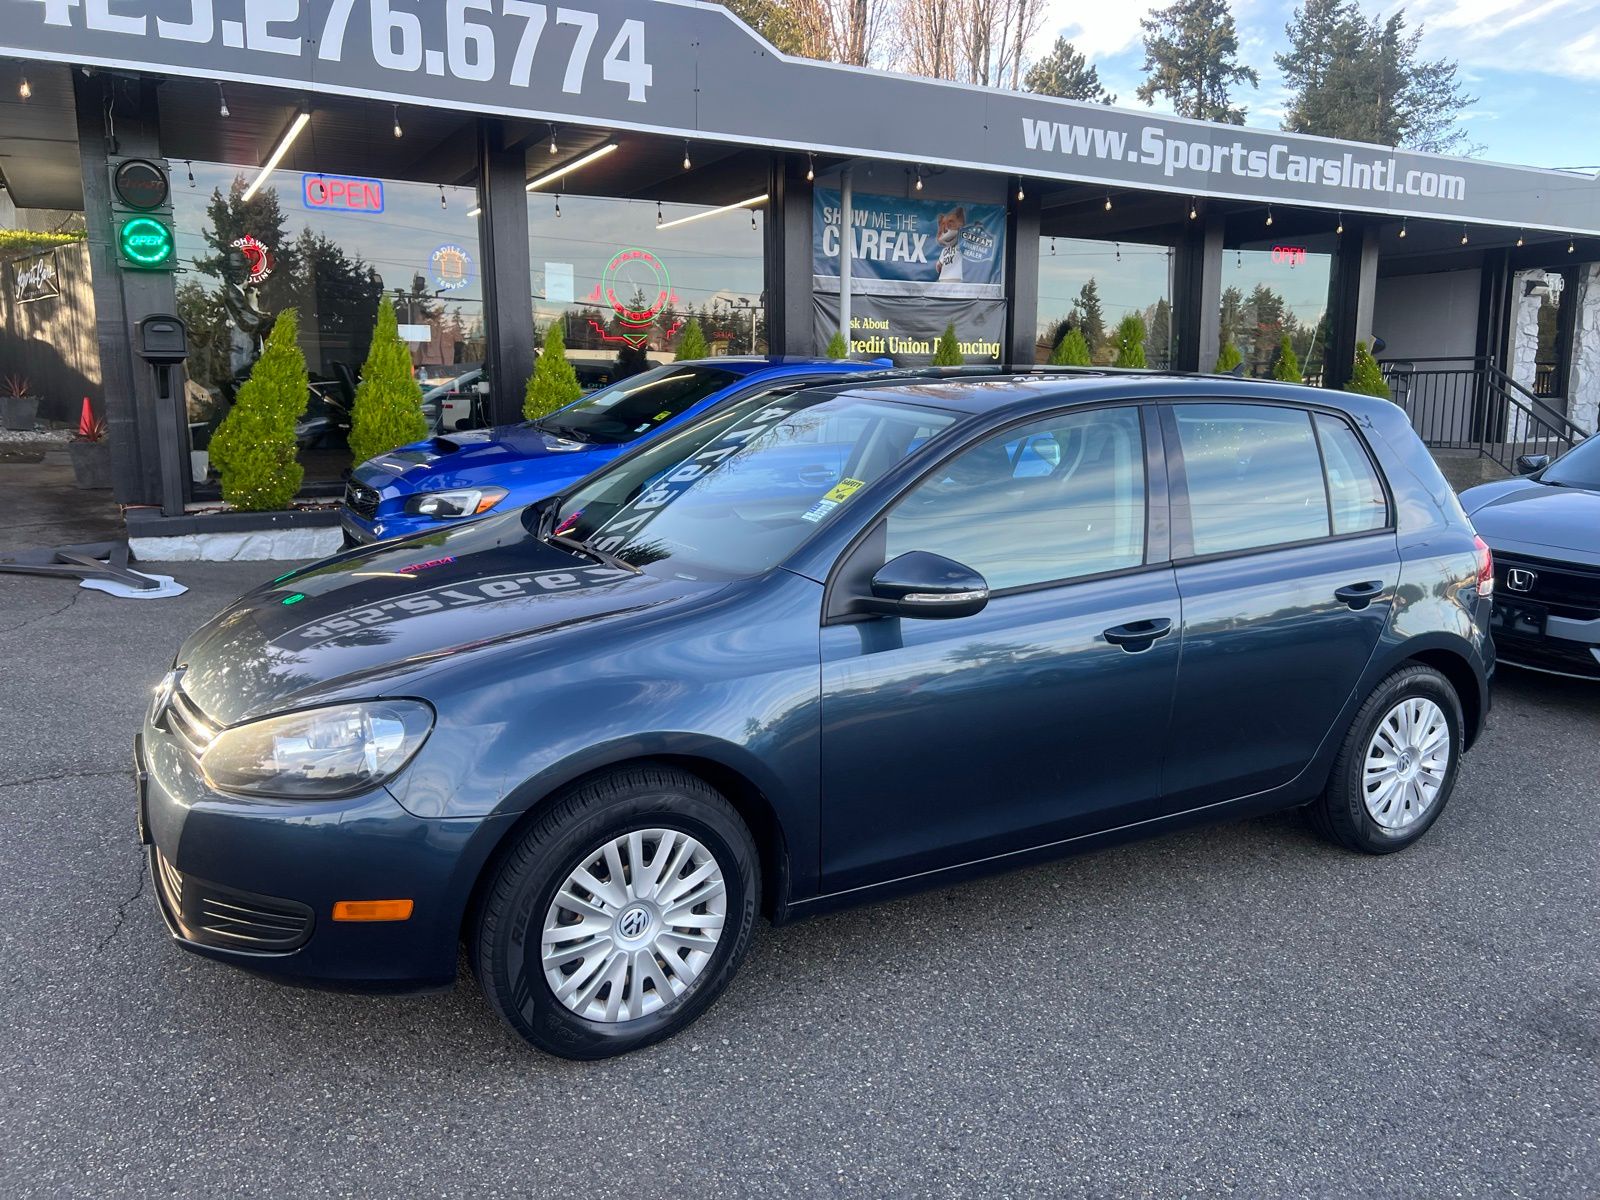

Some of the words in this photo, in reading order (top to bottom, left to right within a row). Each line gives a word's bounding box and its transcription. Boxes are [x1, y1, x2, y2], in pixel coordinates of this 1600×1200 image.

[1021, 117, 1466, 200] www.SportsCarsIntl.com
[306, 178, 380, 209] OPEN
[872, 212, 891, 229] ME
[894, 214, 918, 231] THE
[129, 235, 164, 246] OPEN
[1272, 246, 1306, 264] OPEN
[850, 317, 860, 329] sk
[862, 317, 889, 330] About
[850, 336, 886, 353] redit
[888, 336, 930, 354] Union
